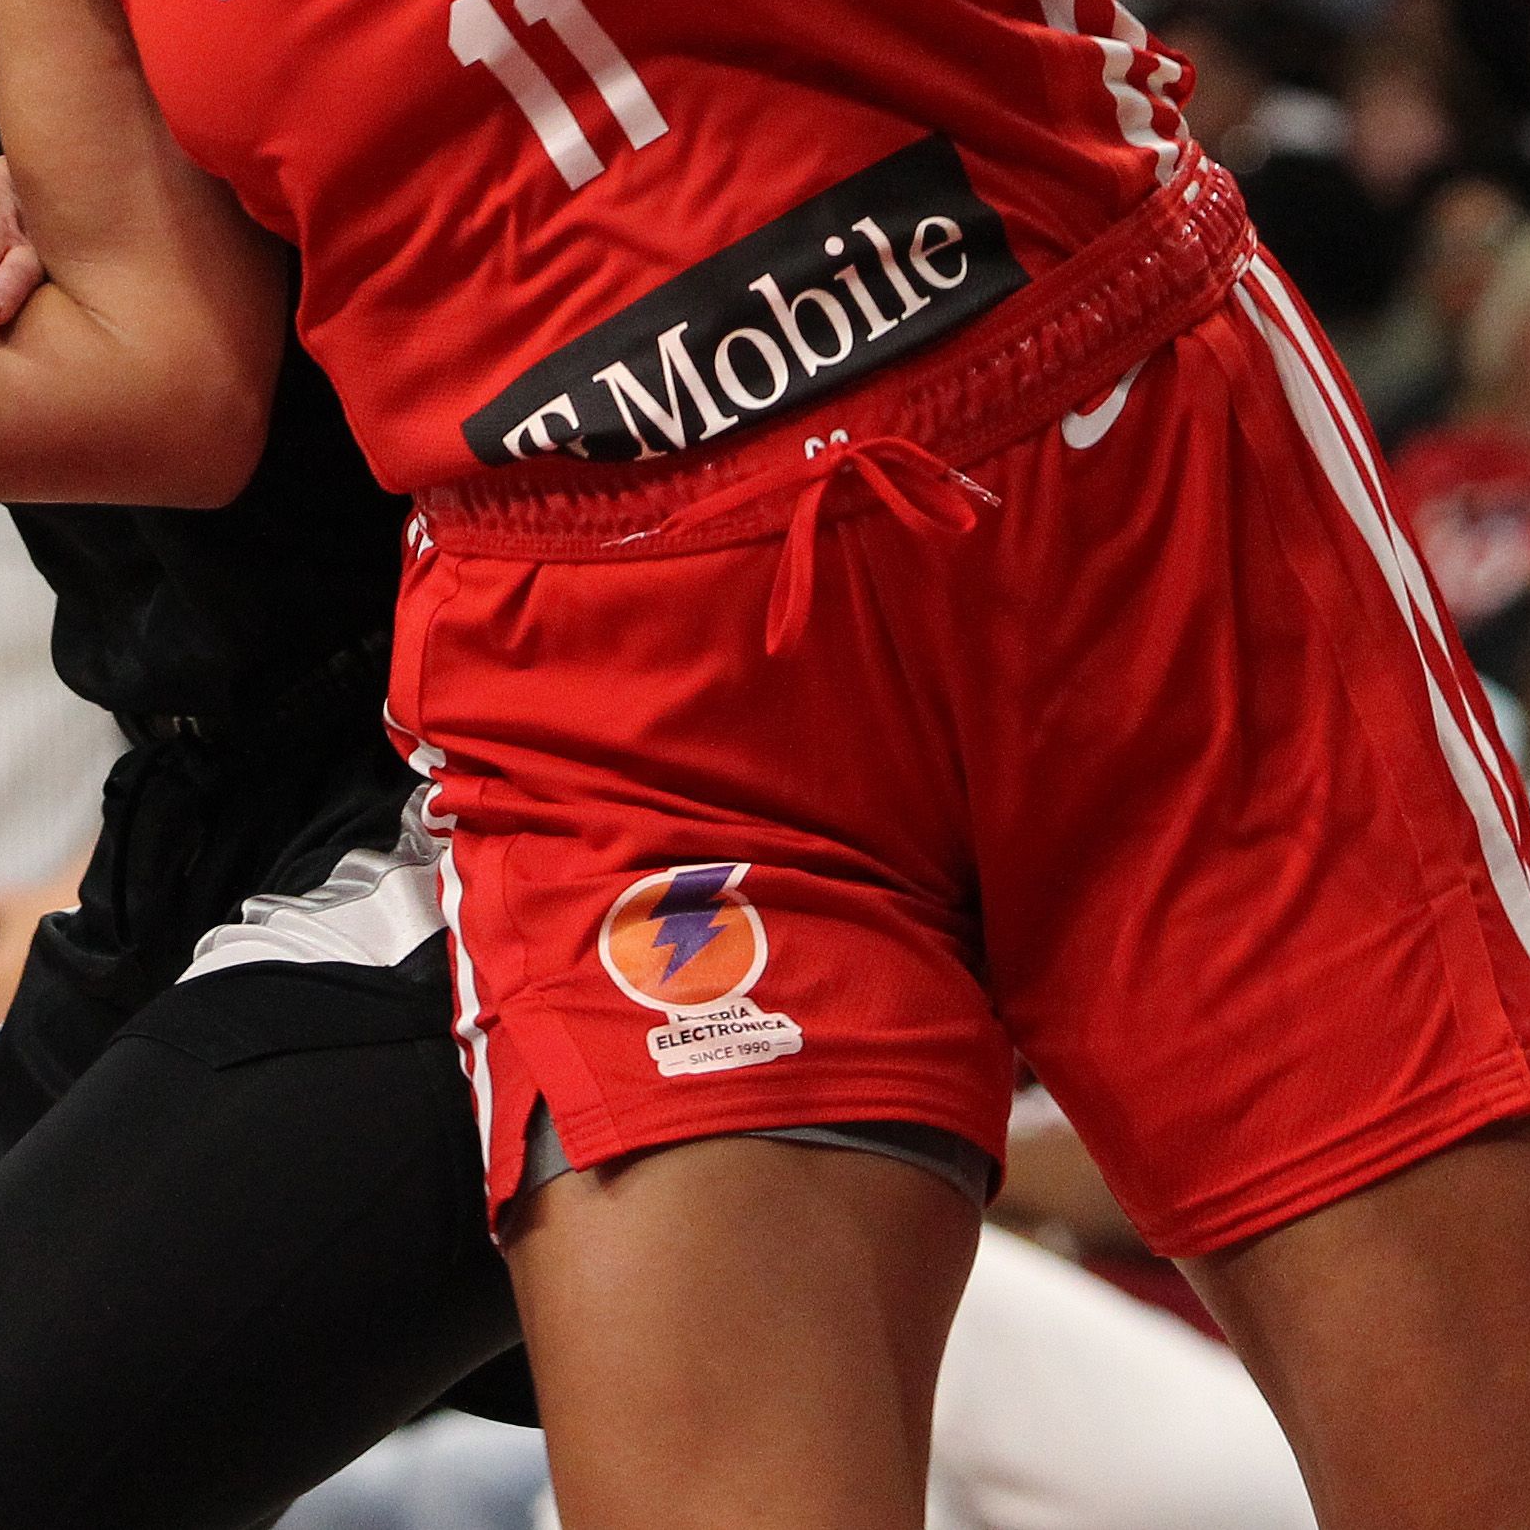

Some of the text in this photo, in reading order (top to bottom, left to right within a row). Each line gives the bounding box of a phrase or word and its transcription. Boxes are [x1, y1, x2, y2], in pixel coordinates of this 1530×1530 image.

[656, 1019, 789, 1050] ELECTRÓNICA
[689, 1040, 771, 1065] SINCE 1990
